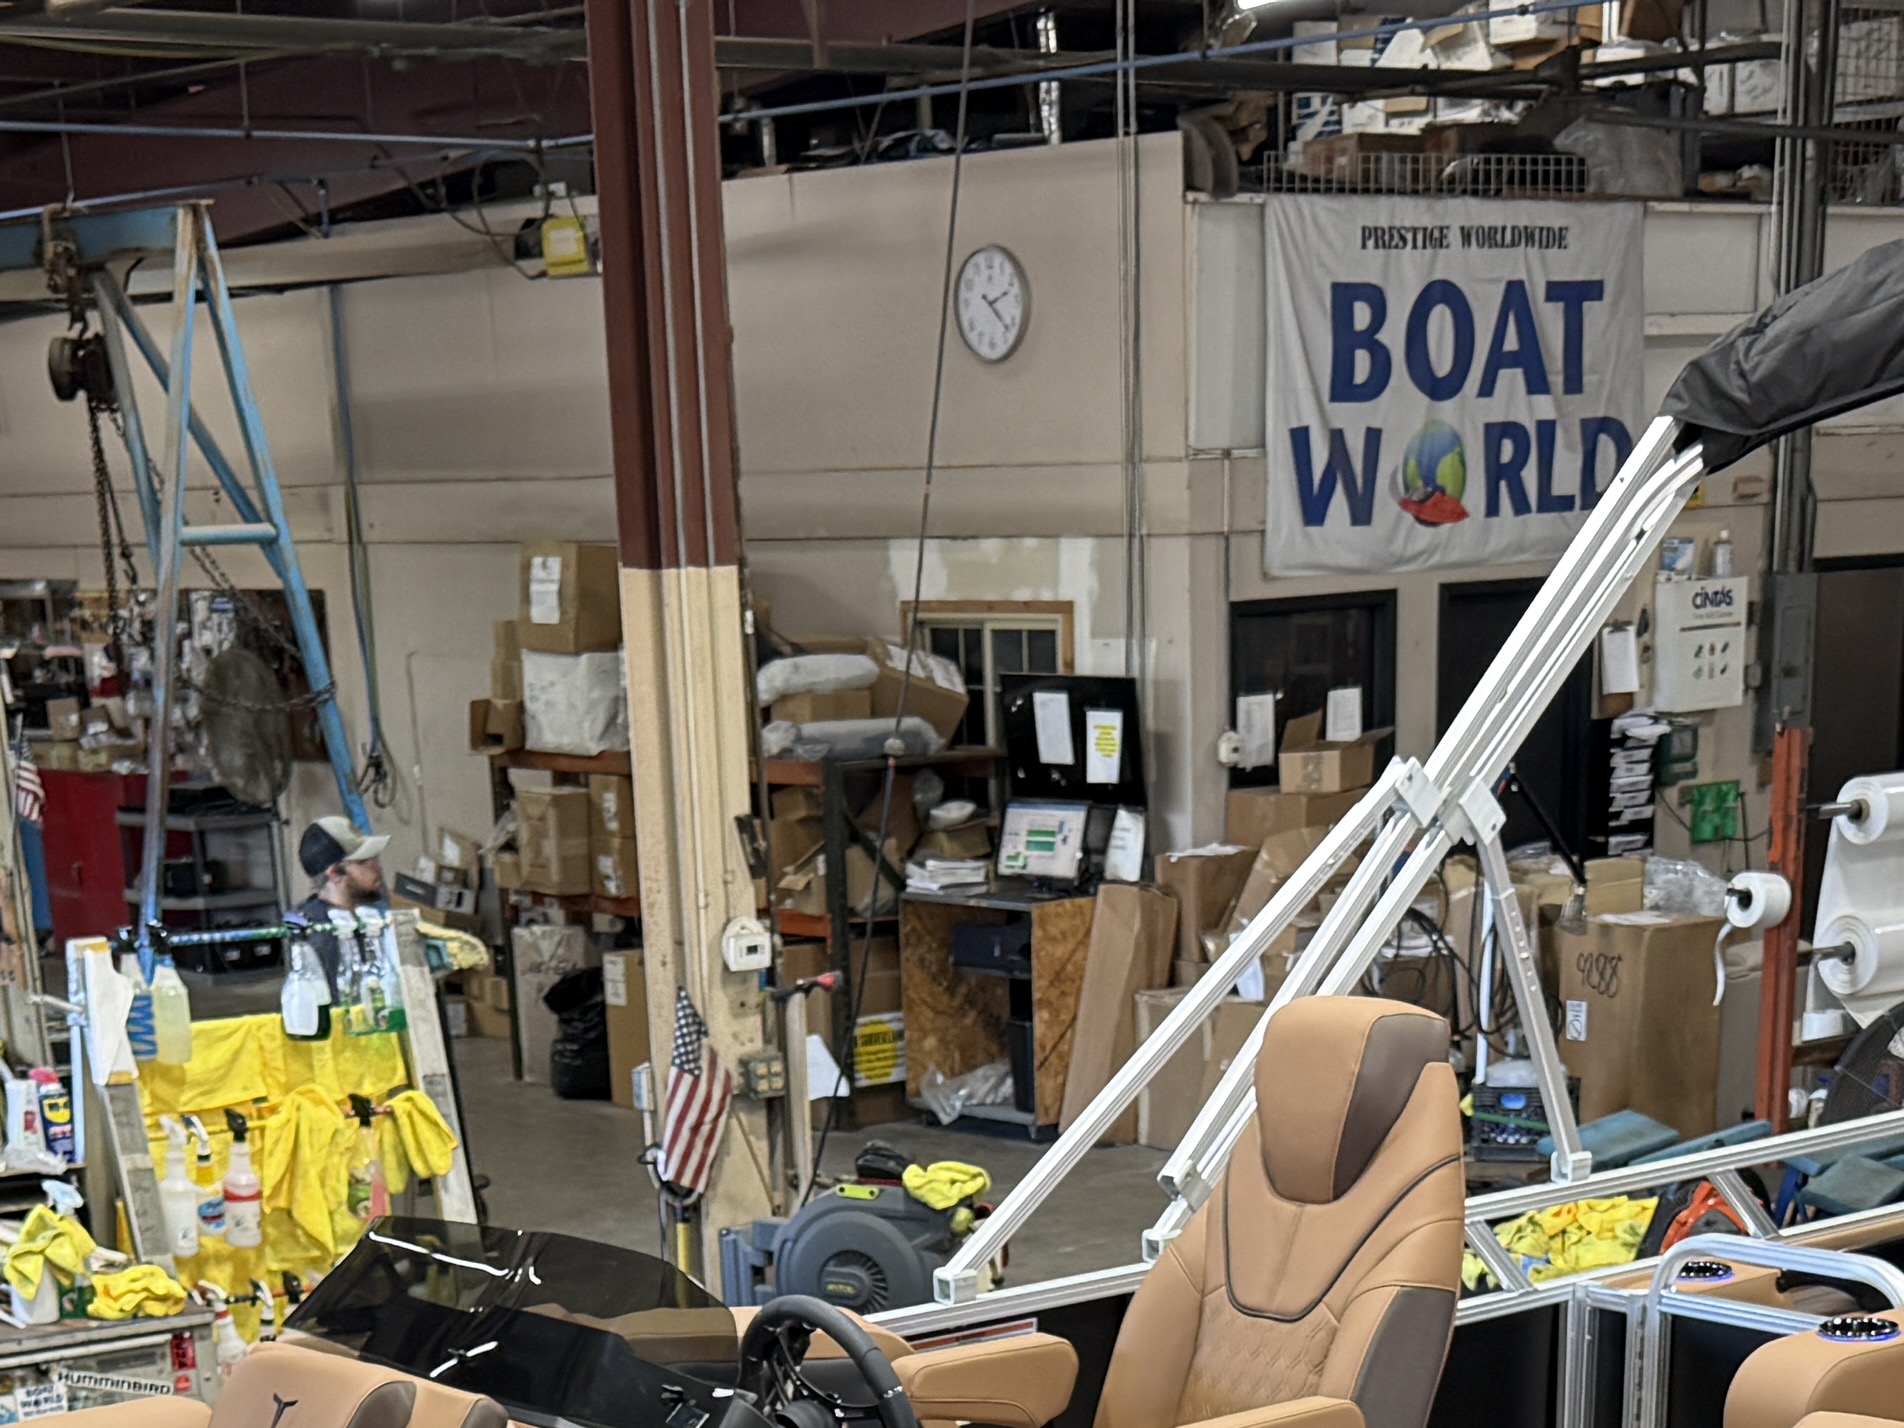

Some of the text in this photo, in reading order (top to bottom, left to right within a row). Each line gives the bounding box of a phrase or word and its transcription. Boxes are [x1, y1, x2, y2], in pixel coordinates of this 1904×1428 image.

[1360, 224, 1570, 251] PRESTIGE WORLDWIDE
[1328, 278, 1605, 404] BOAT
